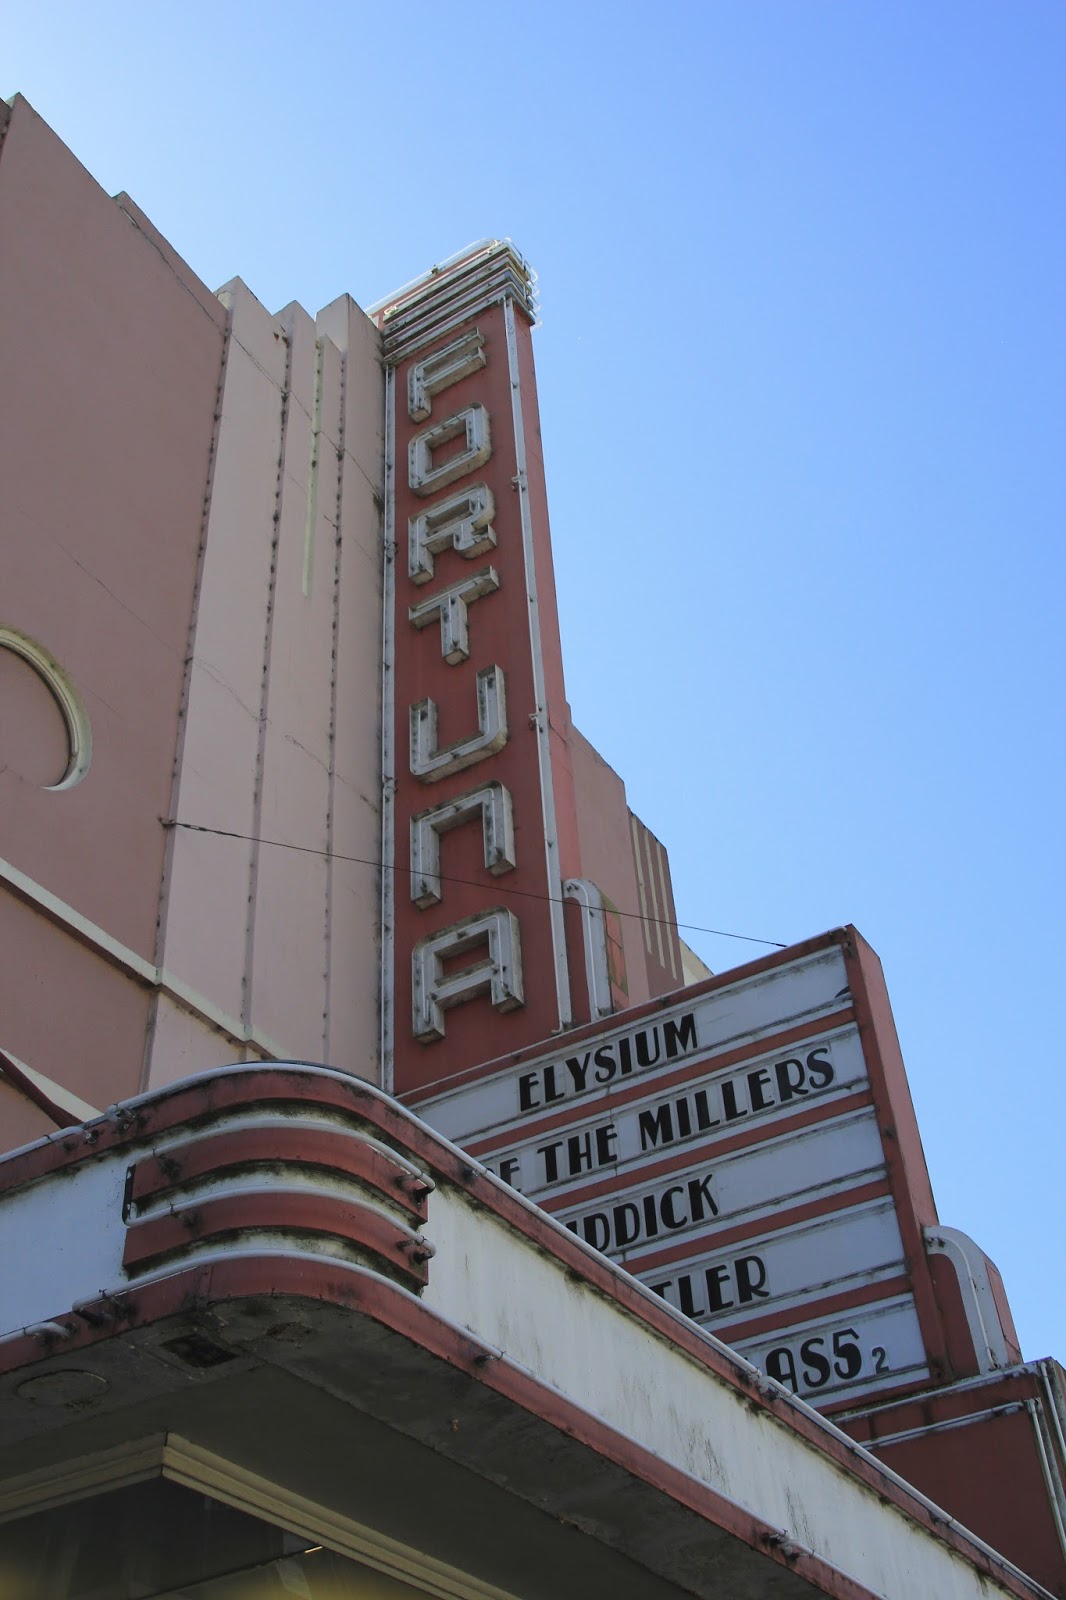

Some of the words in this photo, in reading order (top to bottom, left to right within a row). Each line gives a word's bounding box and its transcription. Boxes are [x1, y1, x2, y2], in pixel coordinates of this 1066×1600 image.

[407, 327, 525, 1043] FORTUNA
[519, 1013, 698, 1112] ELYSIUM
[537, 1124, 618, 1183] THE
[638, 1048, 834, 1151] MILLERS
[871, 1346, 890, 1374] 2
